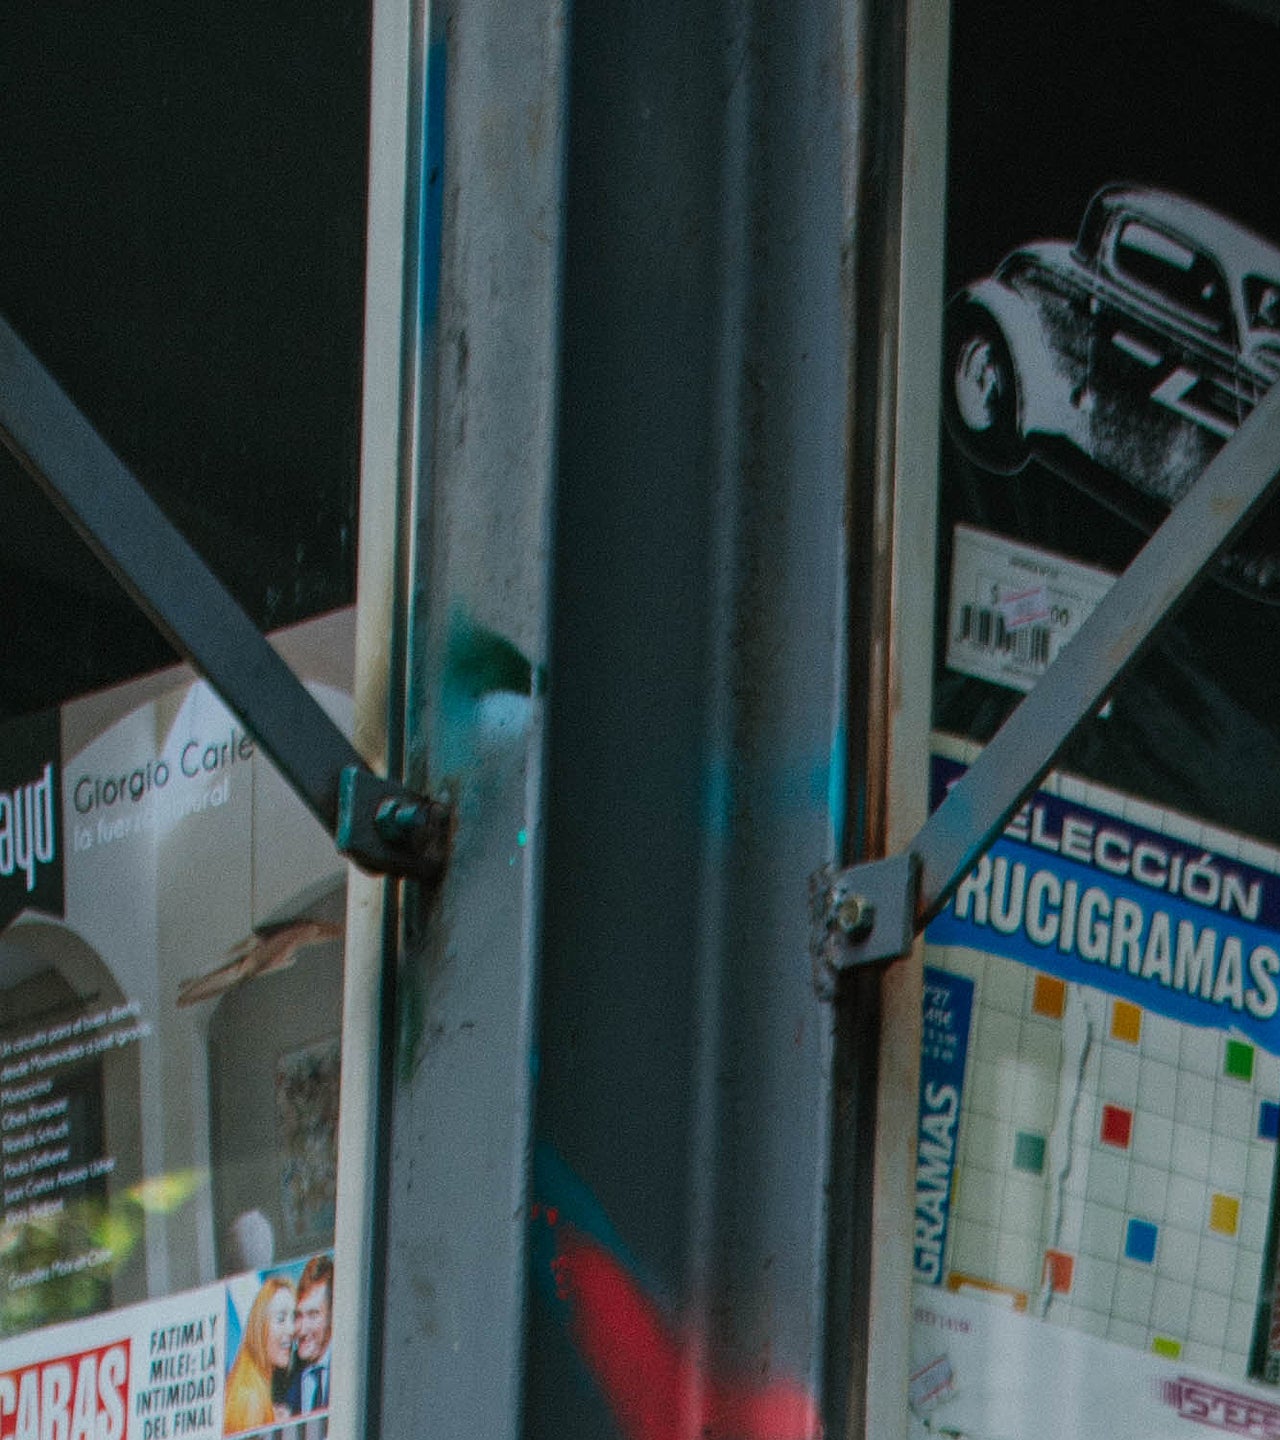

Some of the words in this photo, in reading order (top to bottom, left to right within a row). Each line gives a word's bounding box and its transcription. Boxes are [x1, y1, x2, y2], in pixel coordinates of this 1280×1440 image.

[945, 775, 1262, 922] ELECCIÓN
[136, 1375, 216, 1417] INTIMIDAD
[173, 1404, 214, 1433] FINAL
